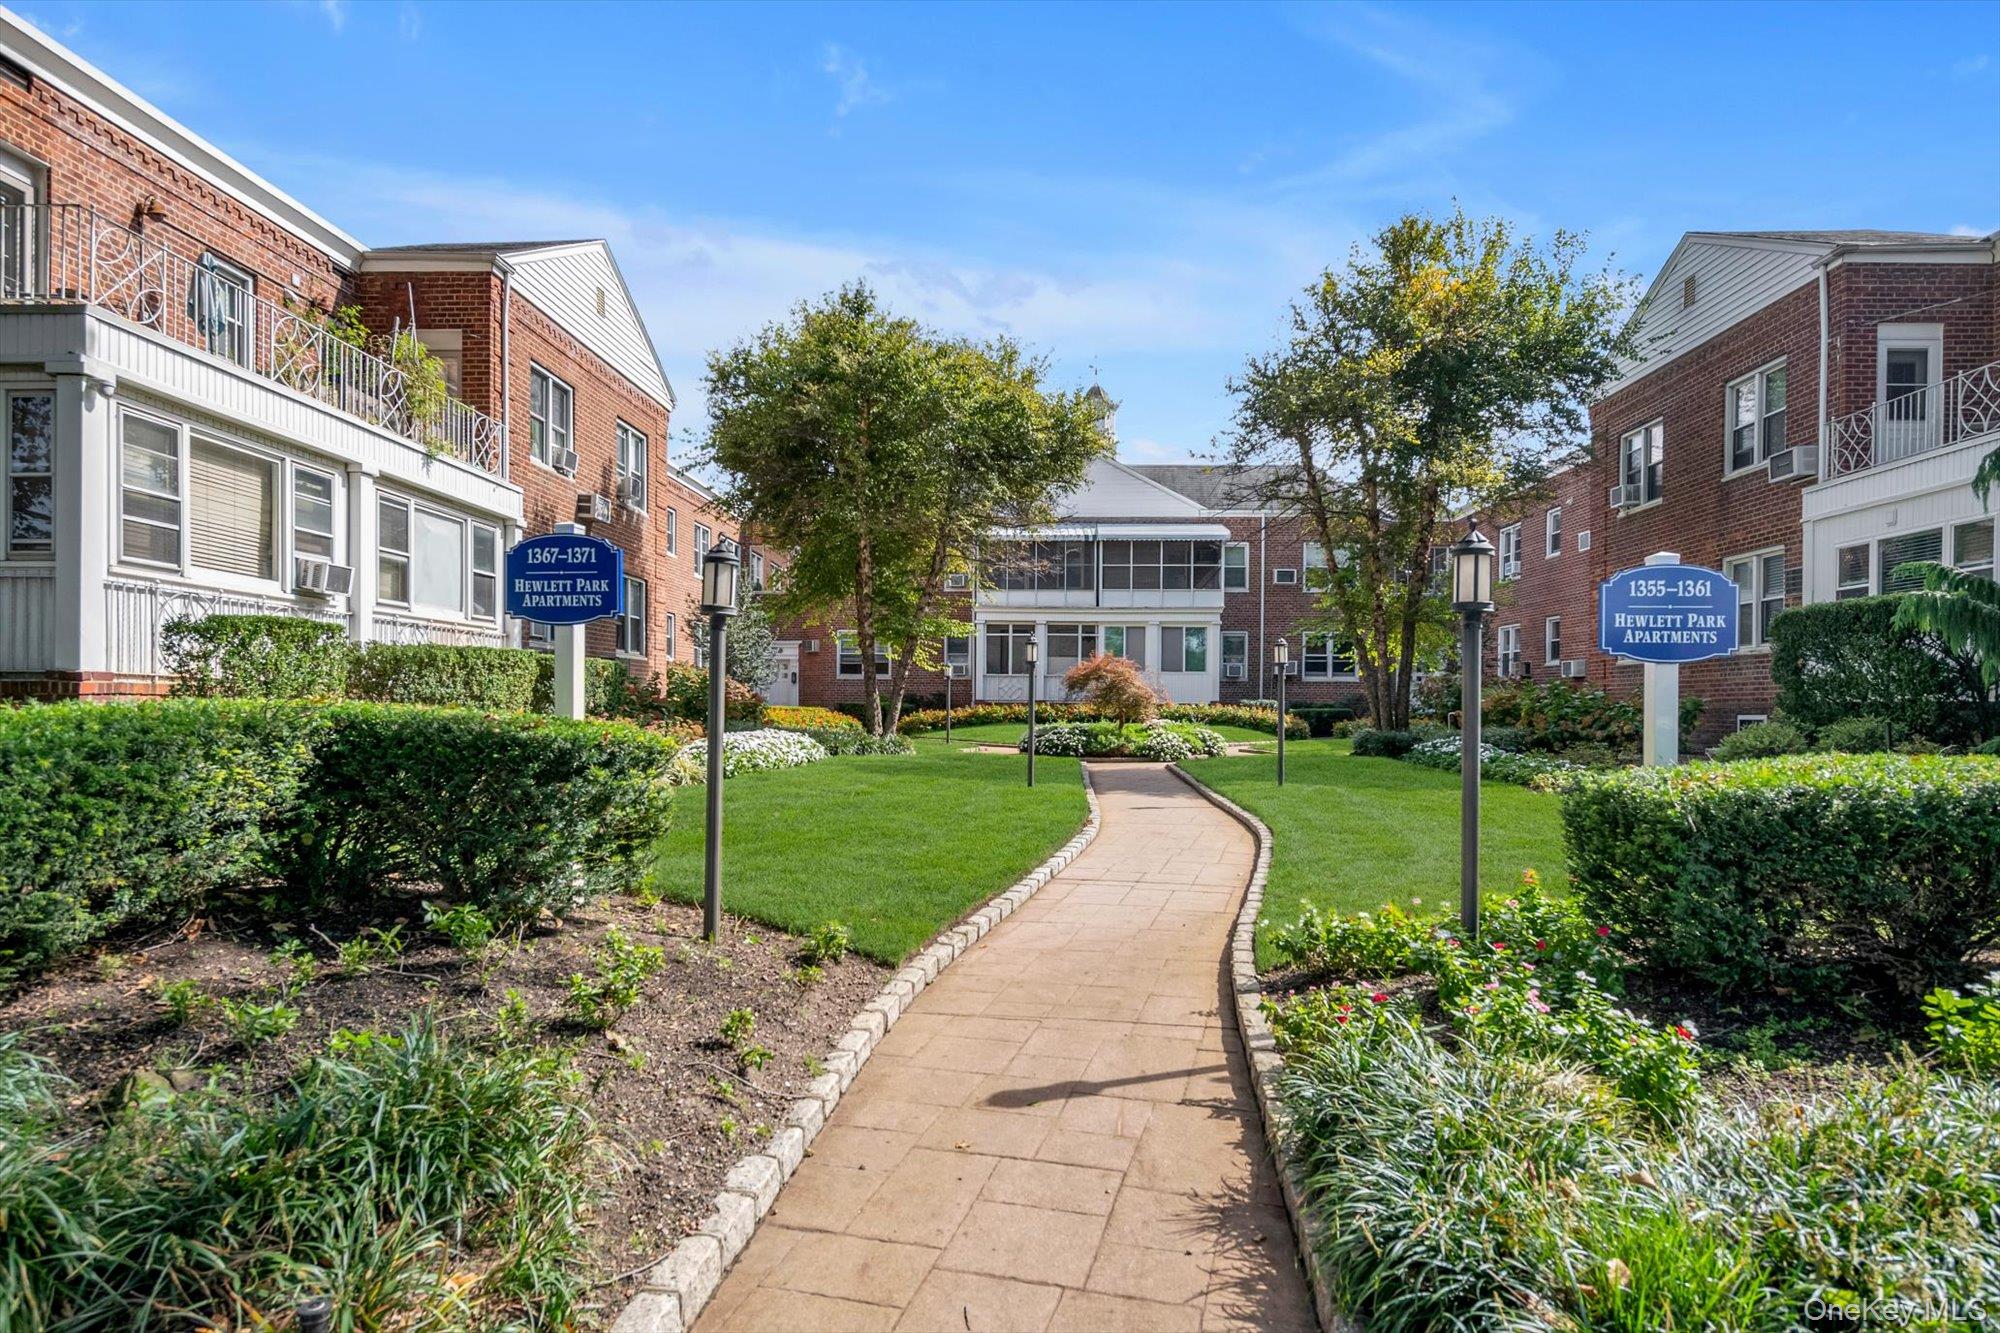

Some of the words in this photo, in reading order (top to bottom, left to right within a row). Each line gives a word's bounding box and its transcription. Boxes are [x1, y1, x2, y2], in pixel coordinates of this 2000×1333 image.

[527, 547, 597, 563] 1367–1371
[514, 579, 573, 593] HEWLETT
[576, 578, 610, 592] PARK
[1629, 579, 1712, 597] 1355–1361
[522, 593, 602, 607] APARTMENTS
[1614, 613, 1683, 628] HEWLETT
[1687, 613, 1726, 628] PARK
[1623, 629, 1718, 644] APARTMENTS
